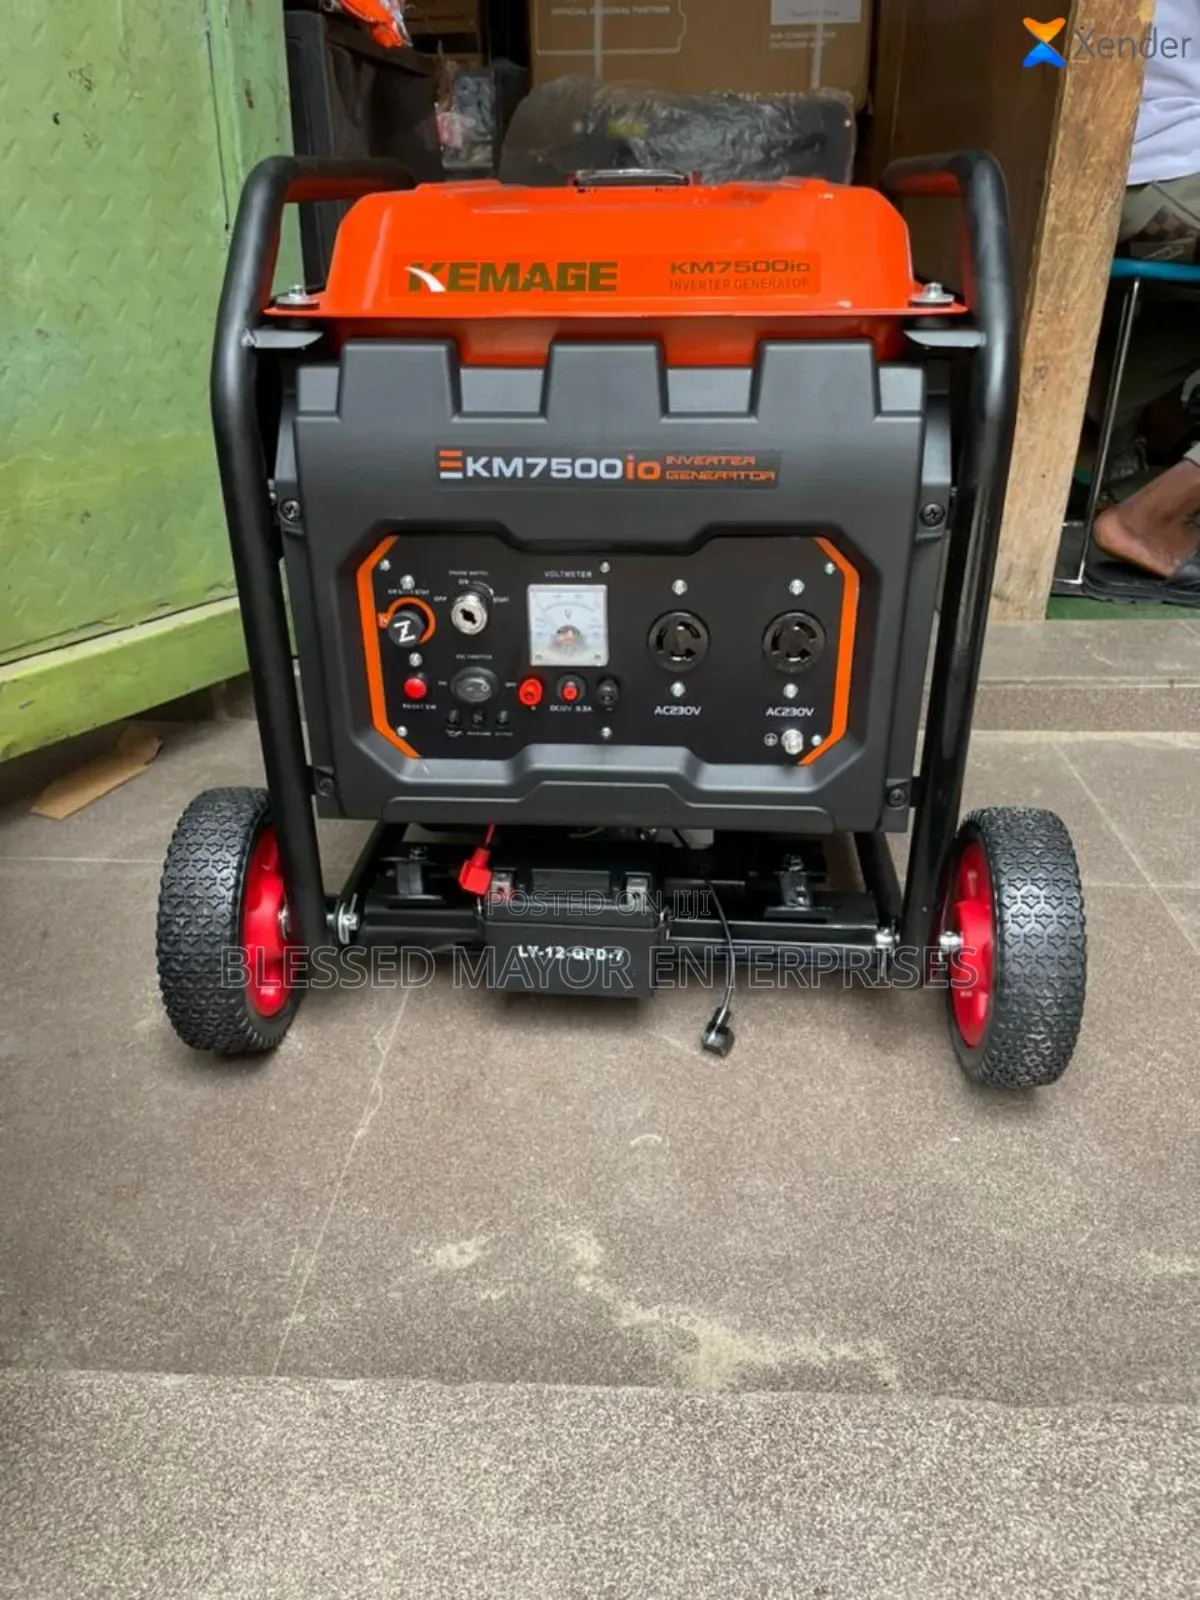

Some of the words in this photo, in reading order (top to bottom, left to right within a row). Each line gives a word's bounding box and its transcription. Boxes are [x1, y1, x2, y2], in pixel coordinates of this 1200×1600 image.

[669, 261, 811, 274] KM7500io
[404, 261, 618, 293] KEMAGE
[669, 279, 731, 291] INVERTER
[733, 277, 810, 290] GENERATOR
[665, 455, 757, 466] INVERTER
[543, 570, 592, 579] VOLTMETER
[654, 704, 702, 716] AC230V
[765, 706, 814, 718] AC230V
